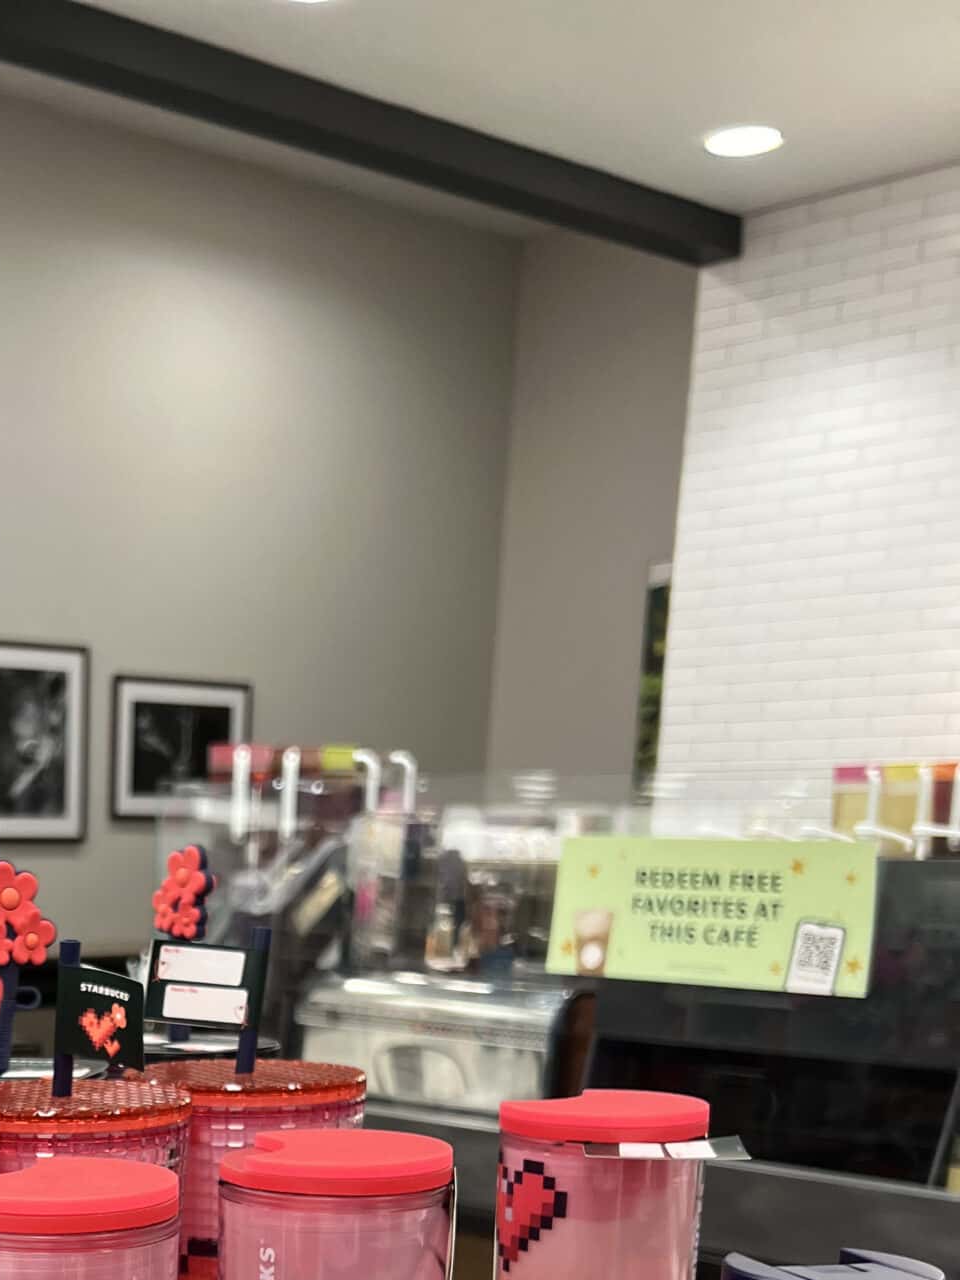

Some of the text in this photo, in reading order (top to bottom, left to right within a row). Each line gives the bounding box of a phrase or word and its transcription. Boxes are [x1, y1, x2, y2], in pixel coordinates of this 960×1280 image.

[635, 869, 784, 893] REDEEM FREE
[631, 897, 784, 921] FAVORITES AT
[649, 922, 697, 945] THIS
